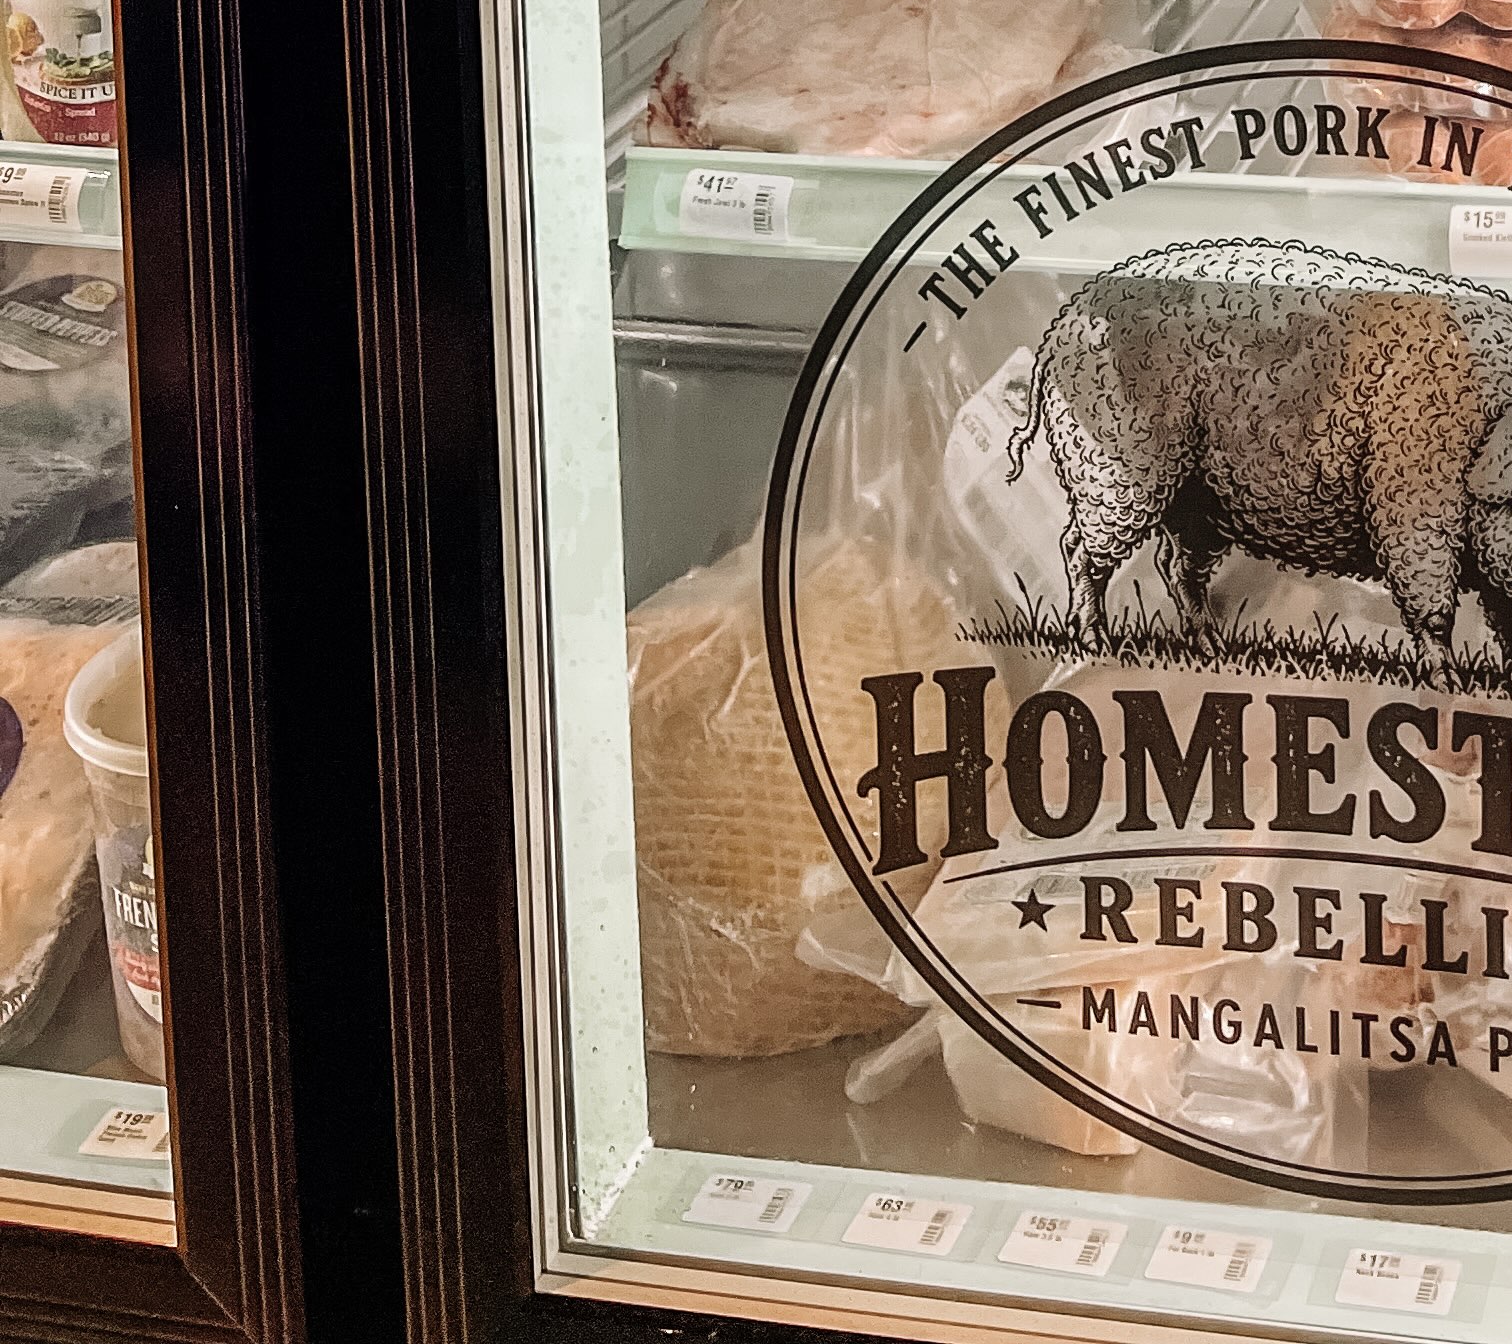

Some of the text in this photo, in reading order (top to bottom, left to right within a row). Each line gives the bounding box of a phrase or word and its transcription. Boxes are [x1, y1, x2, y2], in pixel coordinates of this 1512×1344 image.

[40, 81, 77, 100] SPICE
[81, 87, 98, 100] IT
[918, 218, 1020, 321] THE
[1013, 117, 1207, 240] FINEST
[1231, 104, 1391, 161] PORK
[1418, 114, 1486, 178] IN
[1081, 985, 1460, 1069] MANGALITSA
